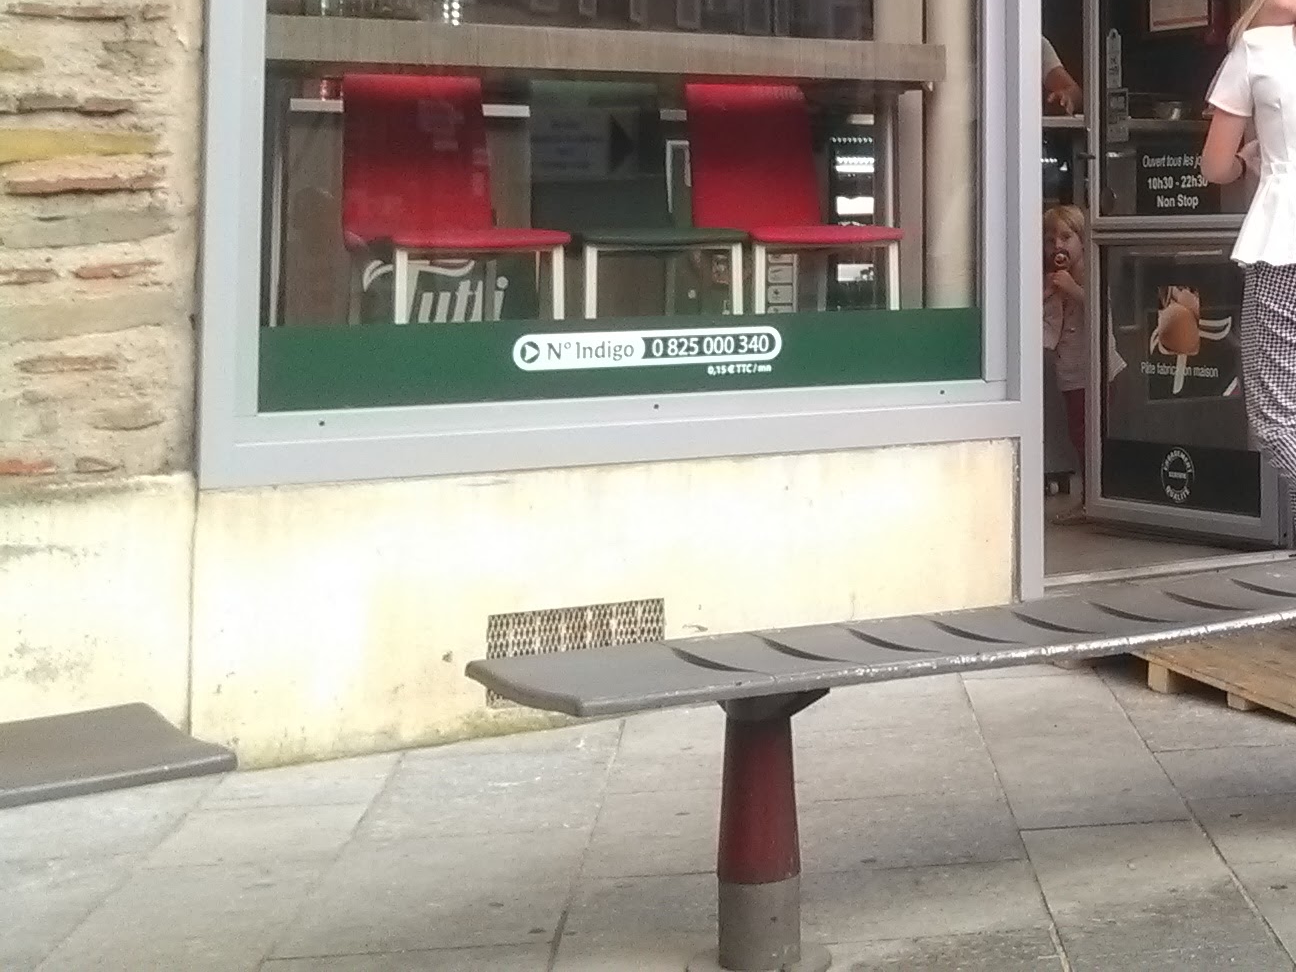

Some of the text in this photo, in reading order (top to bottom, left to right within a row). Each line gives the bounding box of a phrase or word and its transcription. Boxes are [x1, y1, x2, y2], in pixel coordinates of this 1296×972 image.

[1142, 154, 1166, 168] Ouvert
[1167, 154, 1182, 167] tous
[1183, 153, 1194, 167] les
[1147, 176, 1173, 189] 10h30
[1157, 193, 1199, 209] Non Stop
[547, 334, 769, 362] N° Indigo 0 825 000 340
